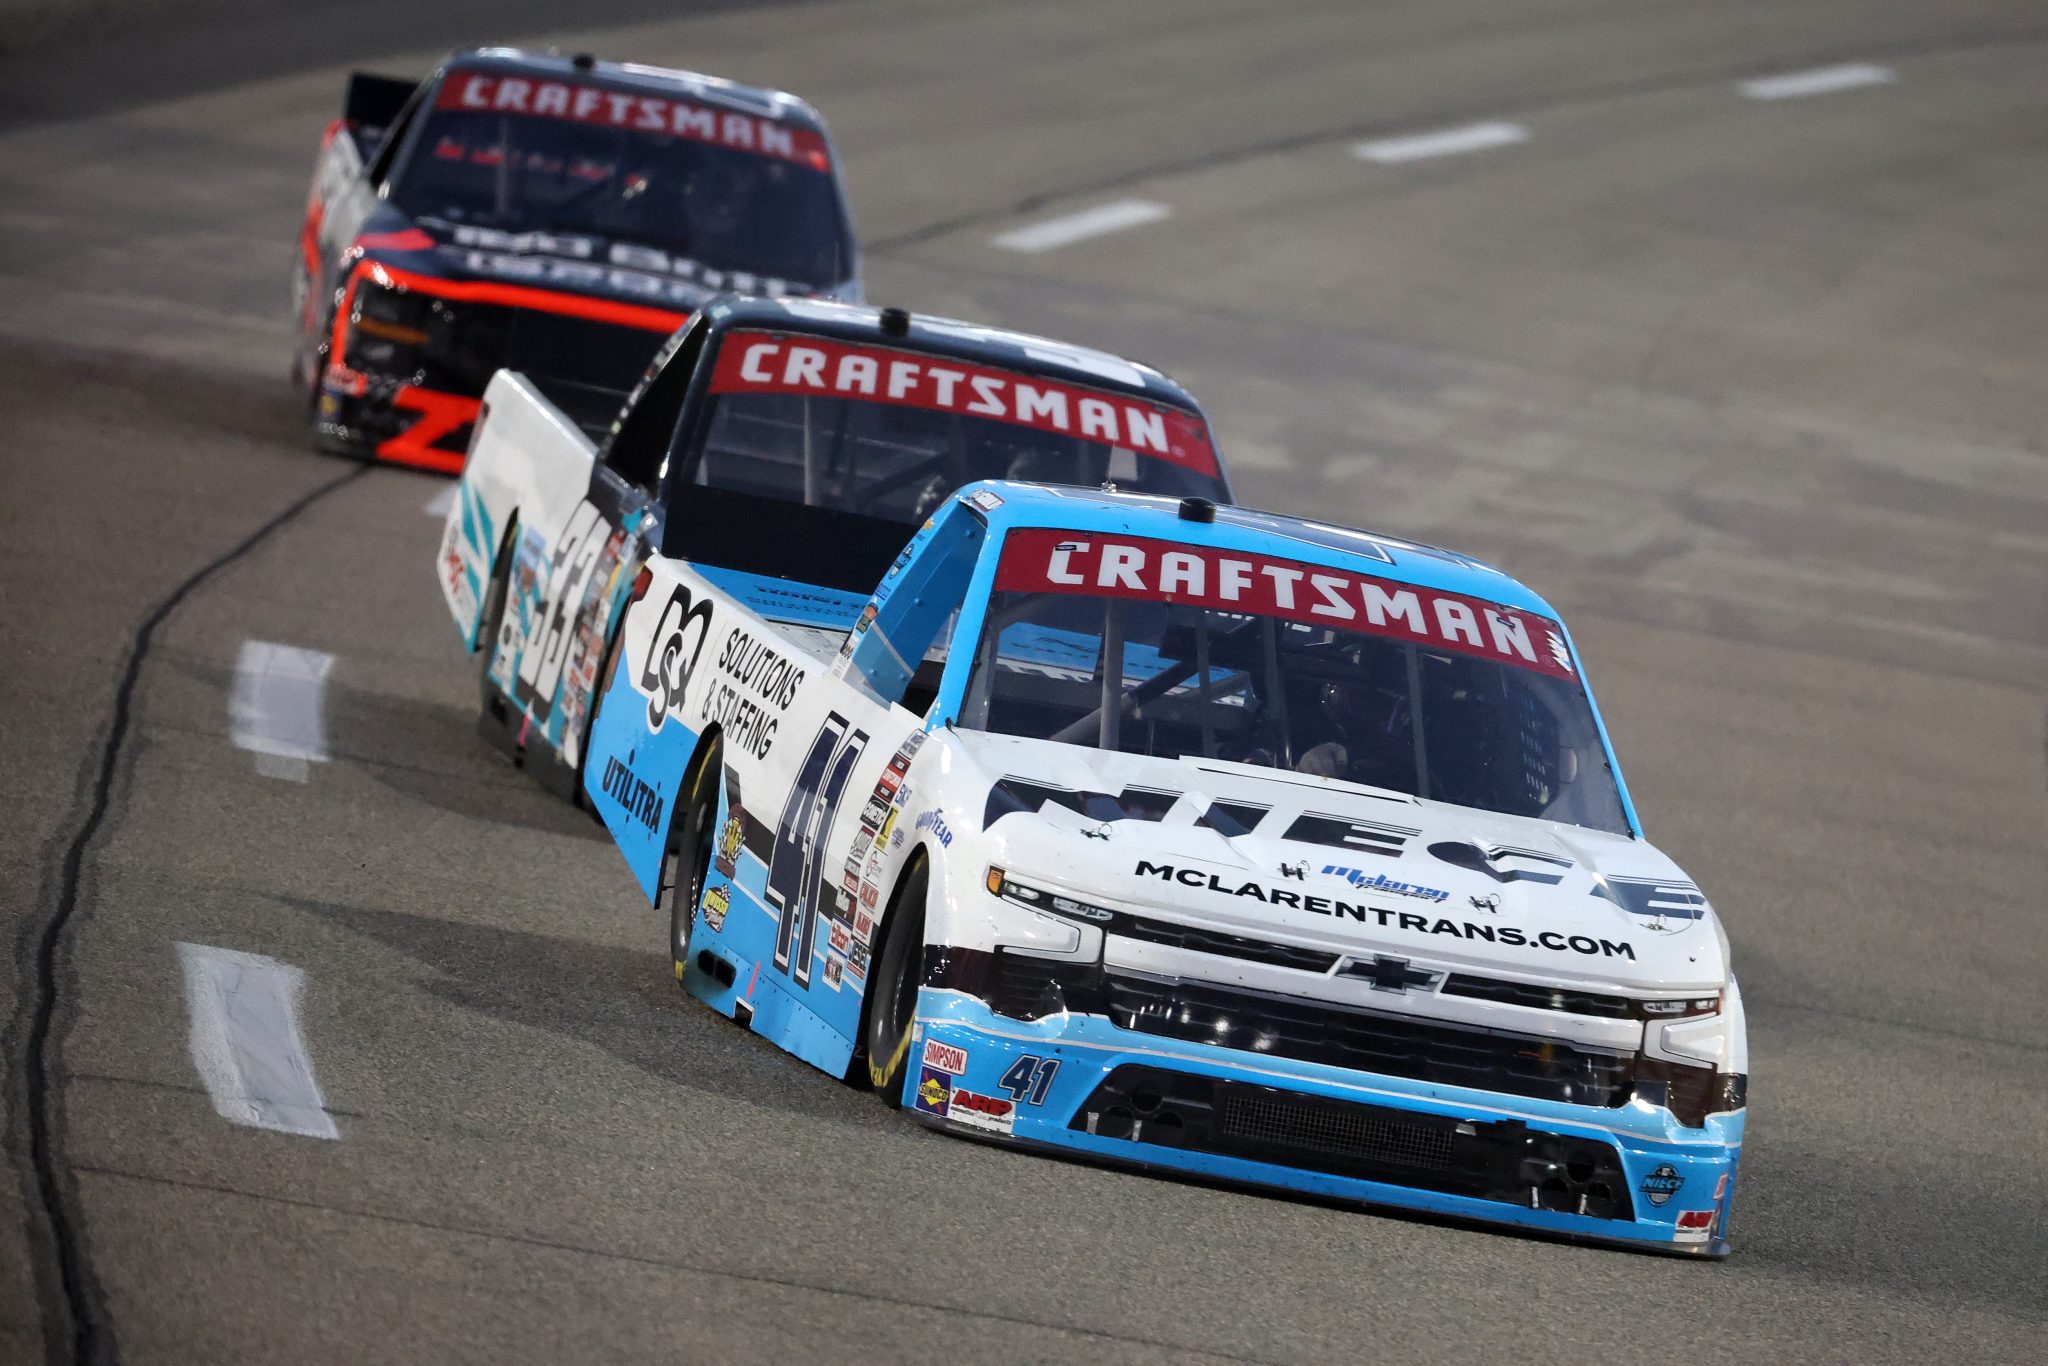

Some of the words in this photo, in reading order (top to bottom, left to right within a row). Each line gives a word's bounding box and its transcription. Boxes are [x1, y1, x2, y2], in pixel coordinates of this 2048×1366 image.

[461, 74, 794, 156] CRAFTSMAN
[740, 343, 1169, 454] CRAFTSMAN
[1046, 540, 1537, 663] CRAFTSMAN
[718, 628, 805, 711] SOLUTIONS
[701, 678, 717, 722] &
[712, 684, 779, 761] STAFFING
[765, 710, 870, 991] 41
[1134, 860, 1637, 962] MCLARENTRANS.COM
[919, 1082, 950, 1102] SUNOCO
[925, 1042, 963, 1072] SIMPSON
[998, 1053, 1062, 1107] 41
[952, 1089, 1013, 1117] ARP
